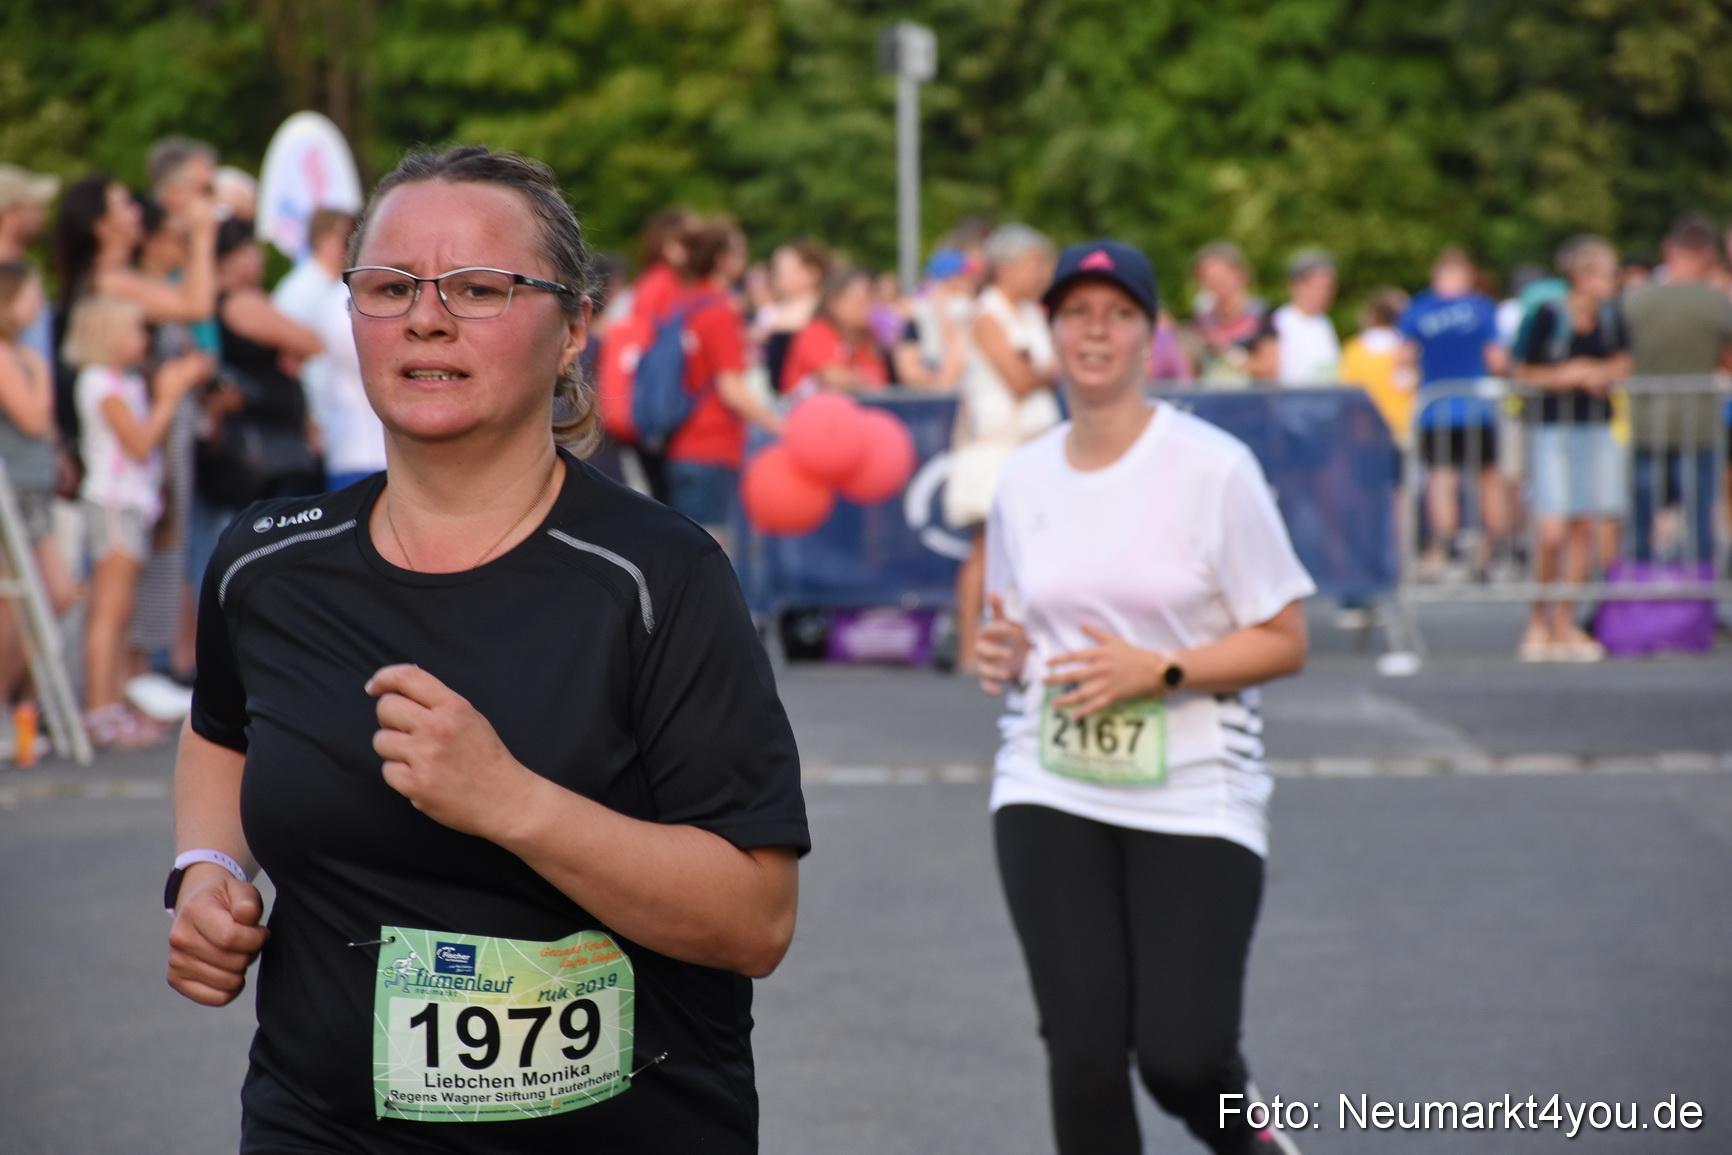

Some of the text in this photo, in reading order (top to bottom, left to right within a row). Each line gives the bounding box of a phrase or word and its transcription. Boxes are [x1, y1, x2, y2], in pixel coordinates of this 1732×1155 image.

[276, 507, 323, 528] JAKO
[1051, 708, 1145, 755] 2167
[415, 967, 515, 993] firmenlauf
[575, 972, 618, 997] 2019
[410, 998, 601, 1070] 1979
[390, 1089, 438, 1104] Regens
[441, 1092, 492, 1105] Wagner
[495, 1089, 546, 1102] Stiftung
[550, 1069, 620, 1097] Lauterhofen
[424, 1064, 591, 1089] Liebchen Monika
